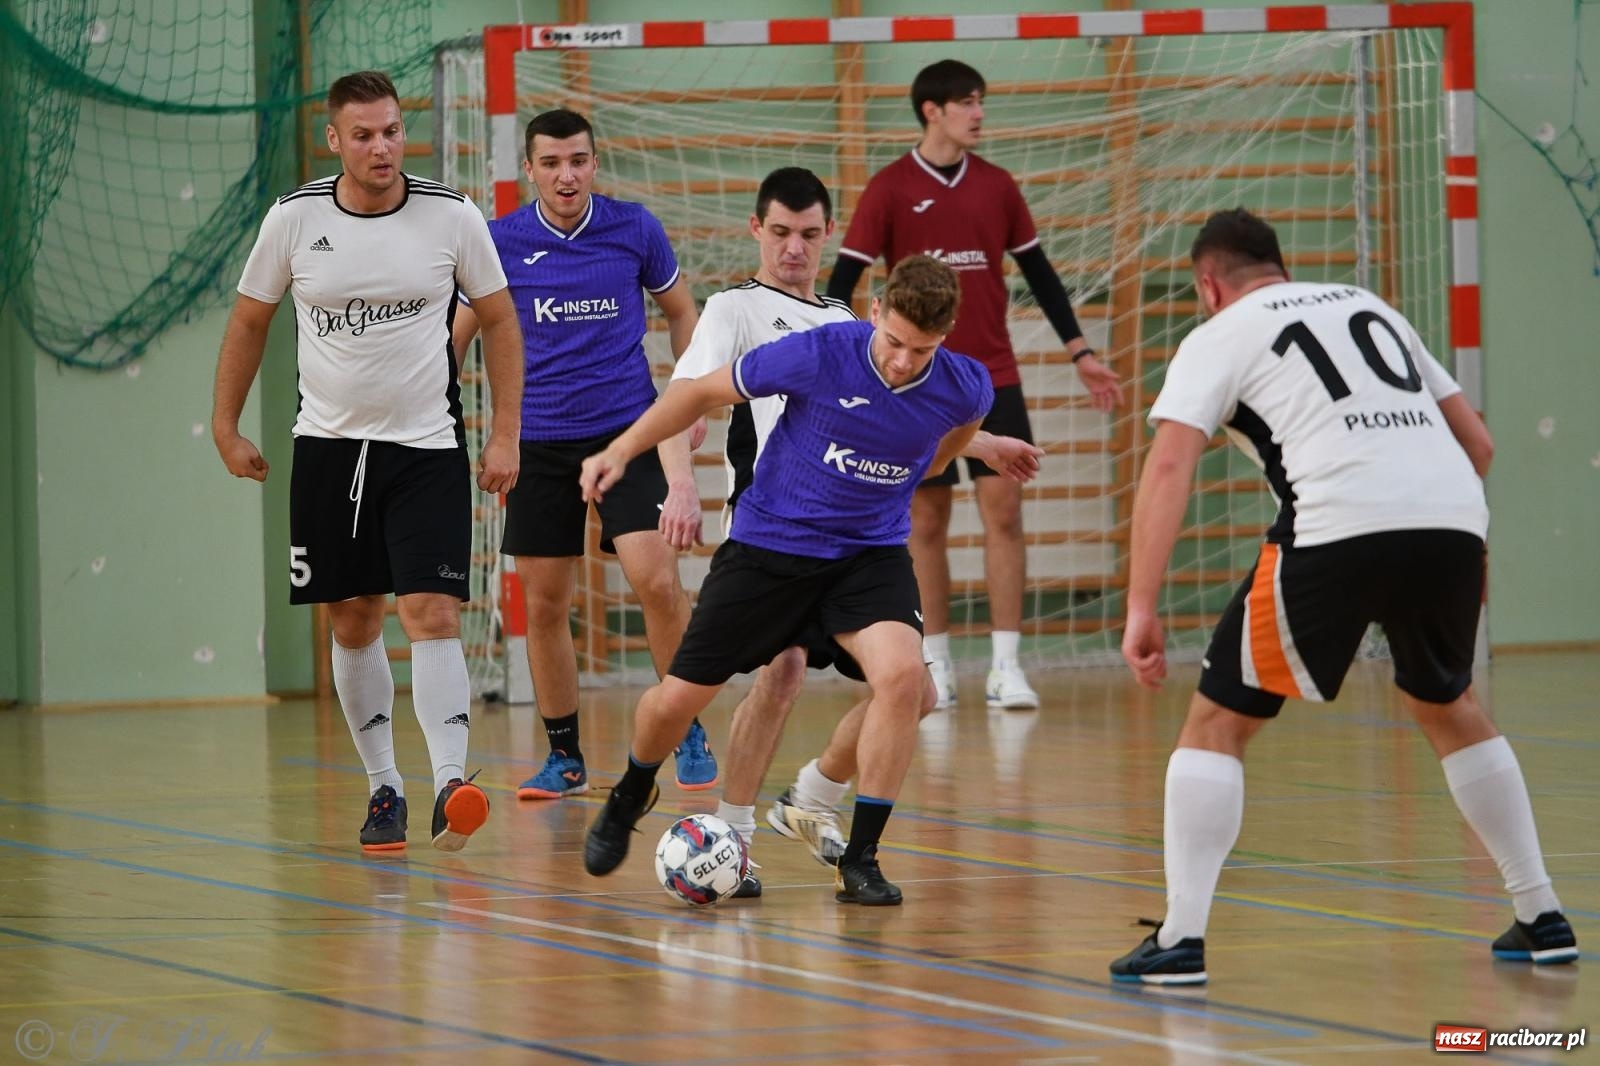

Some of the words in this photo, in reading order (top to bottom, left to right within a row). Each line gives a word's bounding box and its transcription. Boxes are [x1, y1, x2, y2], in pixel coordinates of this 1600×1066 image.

[583, 29, 622, 43] sport
[310, 244, 334, 252] adidas
[534, 297, 619, 322] K-INSTAL
[1271, 310, 1423, 402] 10
[1344, 409, 1434, 431] PŁONIA
[823, 441, 912, 474] K-INSTA
[290, 545, 312, 588] 5
[693, 845, 735, 880] SELECT
